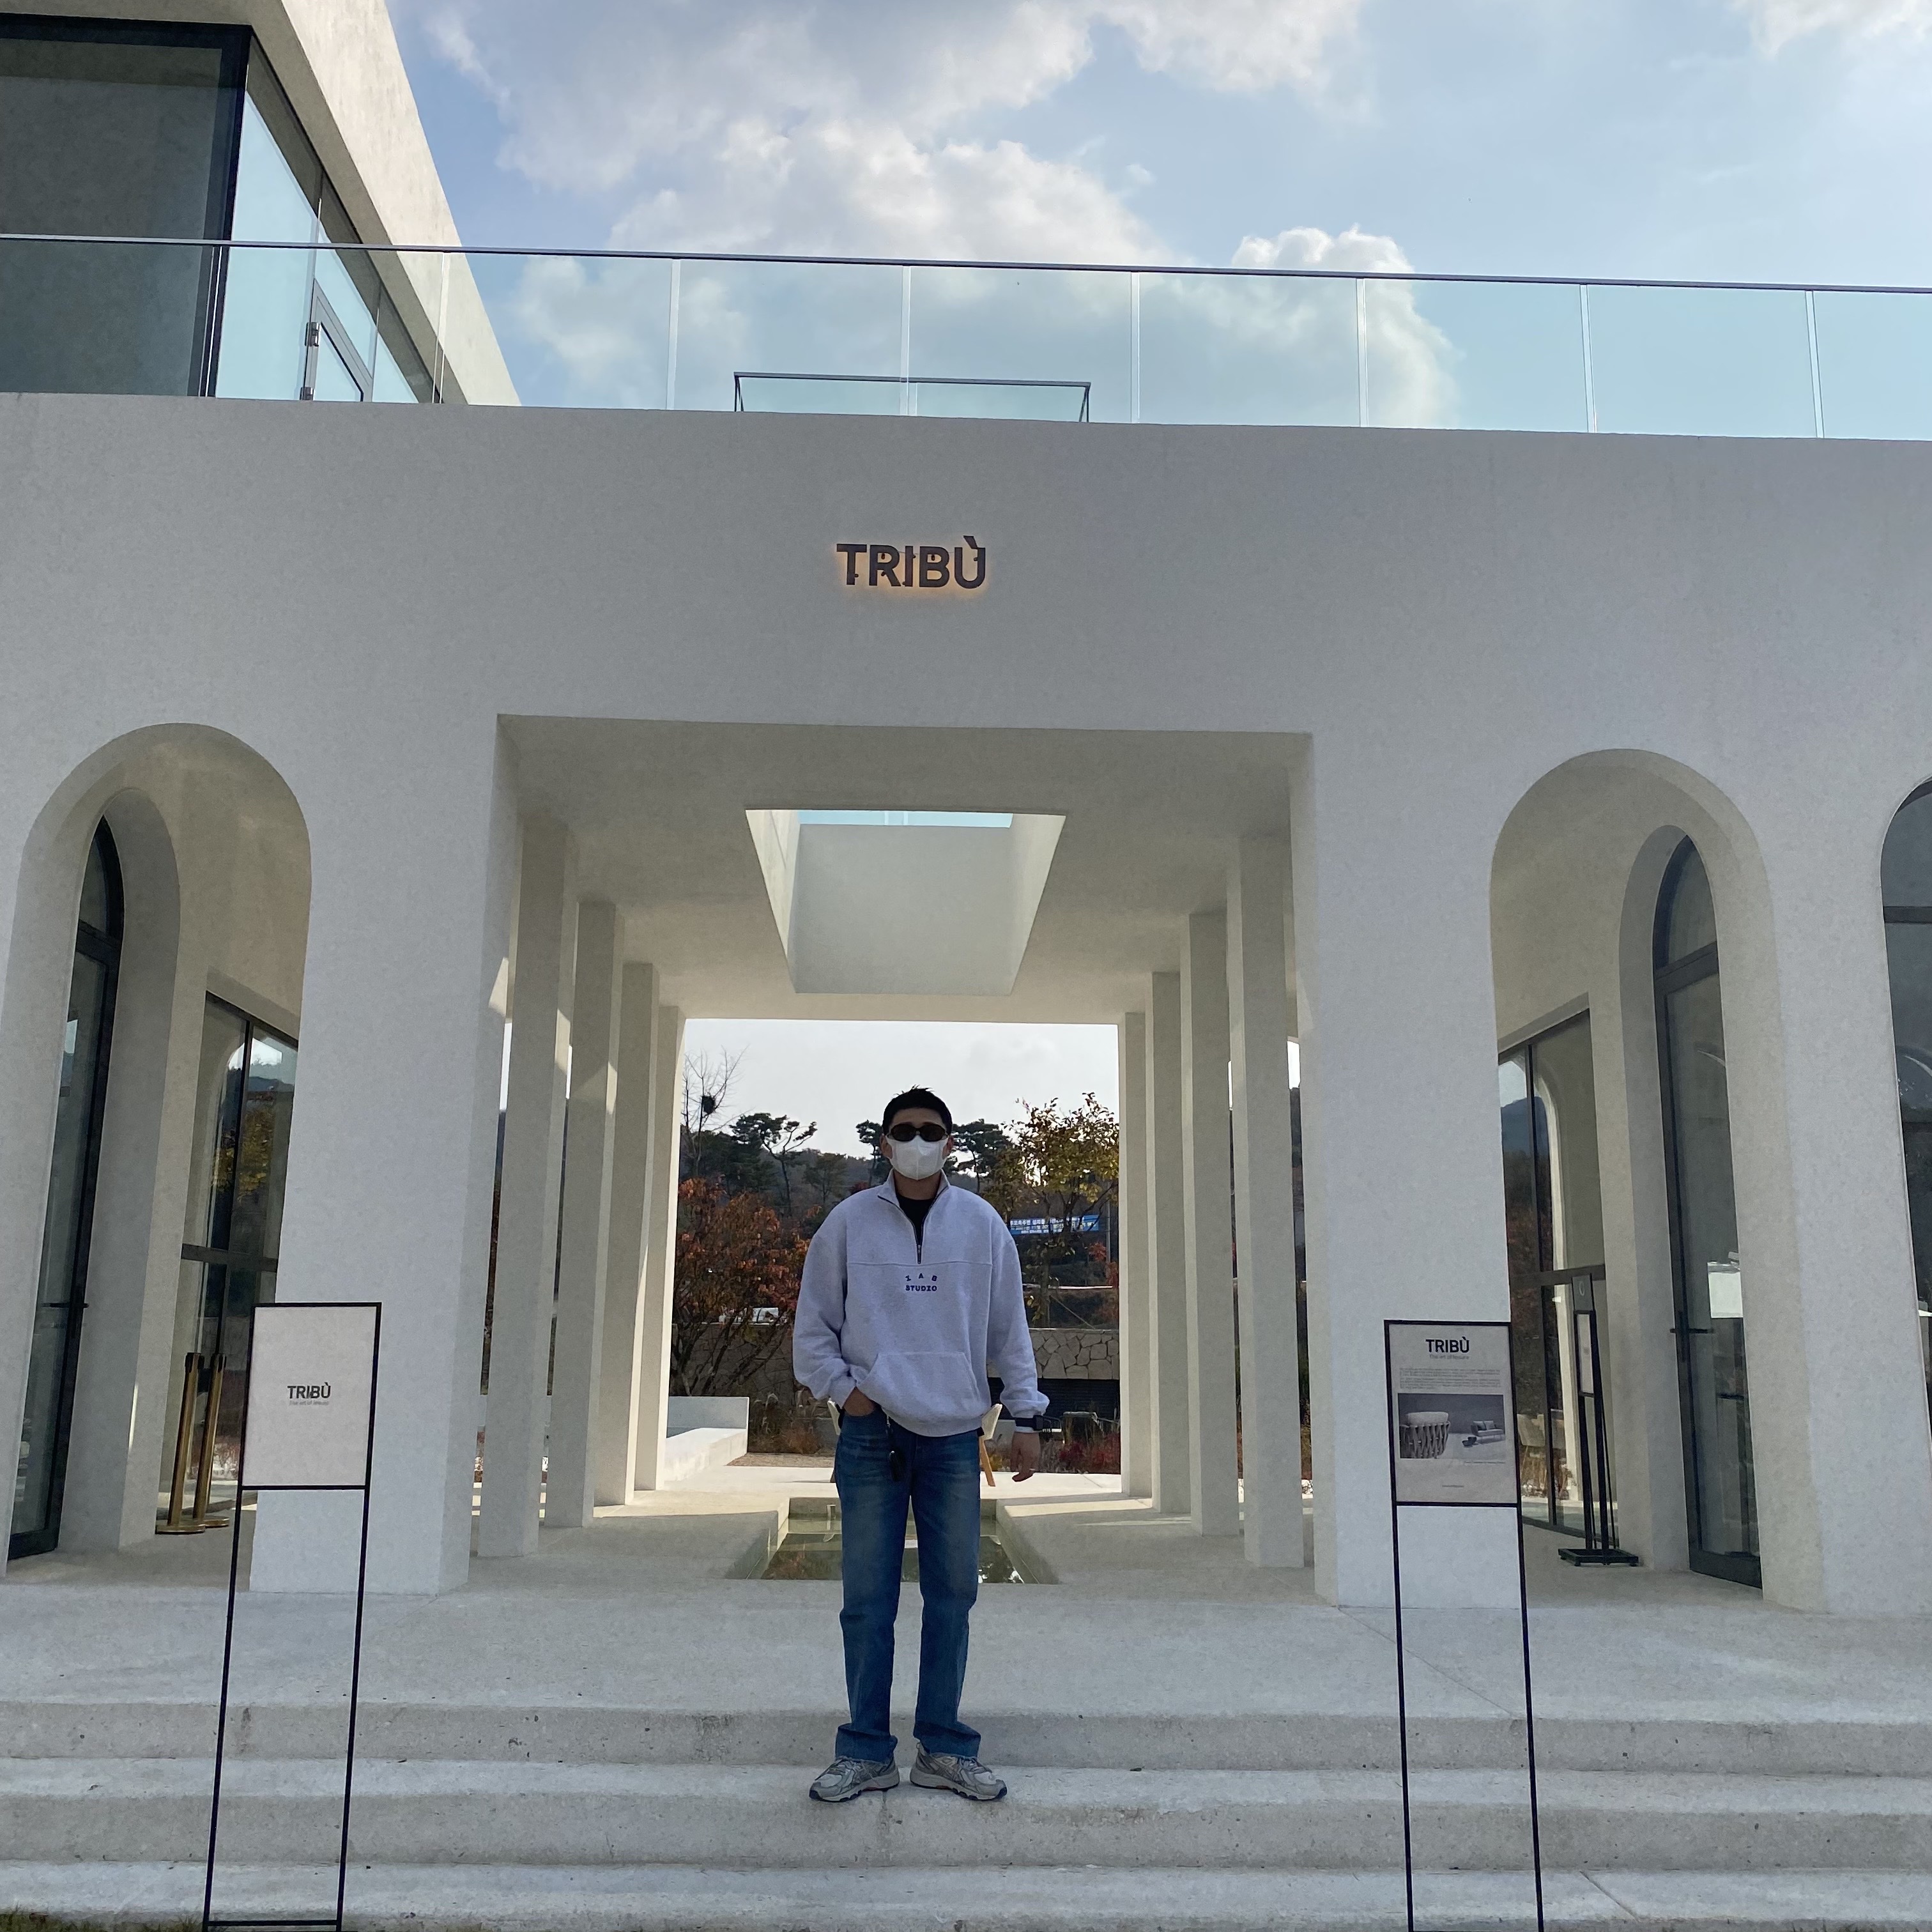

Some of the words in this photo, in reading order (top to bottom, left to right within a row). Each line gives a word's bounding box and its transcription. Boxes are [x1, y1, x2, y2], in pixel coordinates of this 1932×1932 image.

[836, 535, 986, 589] TRIBÙ
[1425, 1336, 1469, 1353] TRIBÙ
[287, 1381, 331, 1399] TRIBÙ
